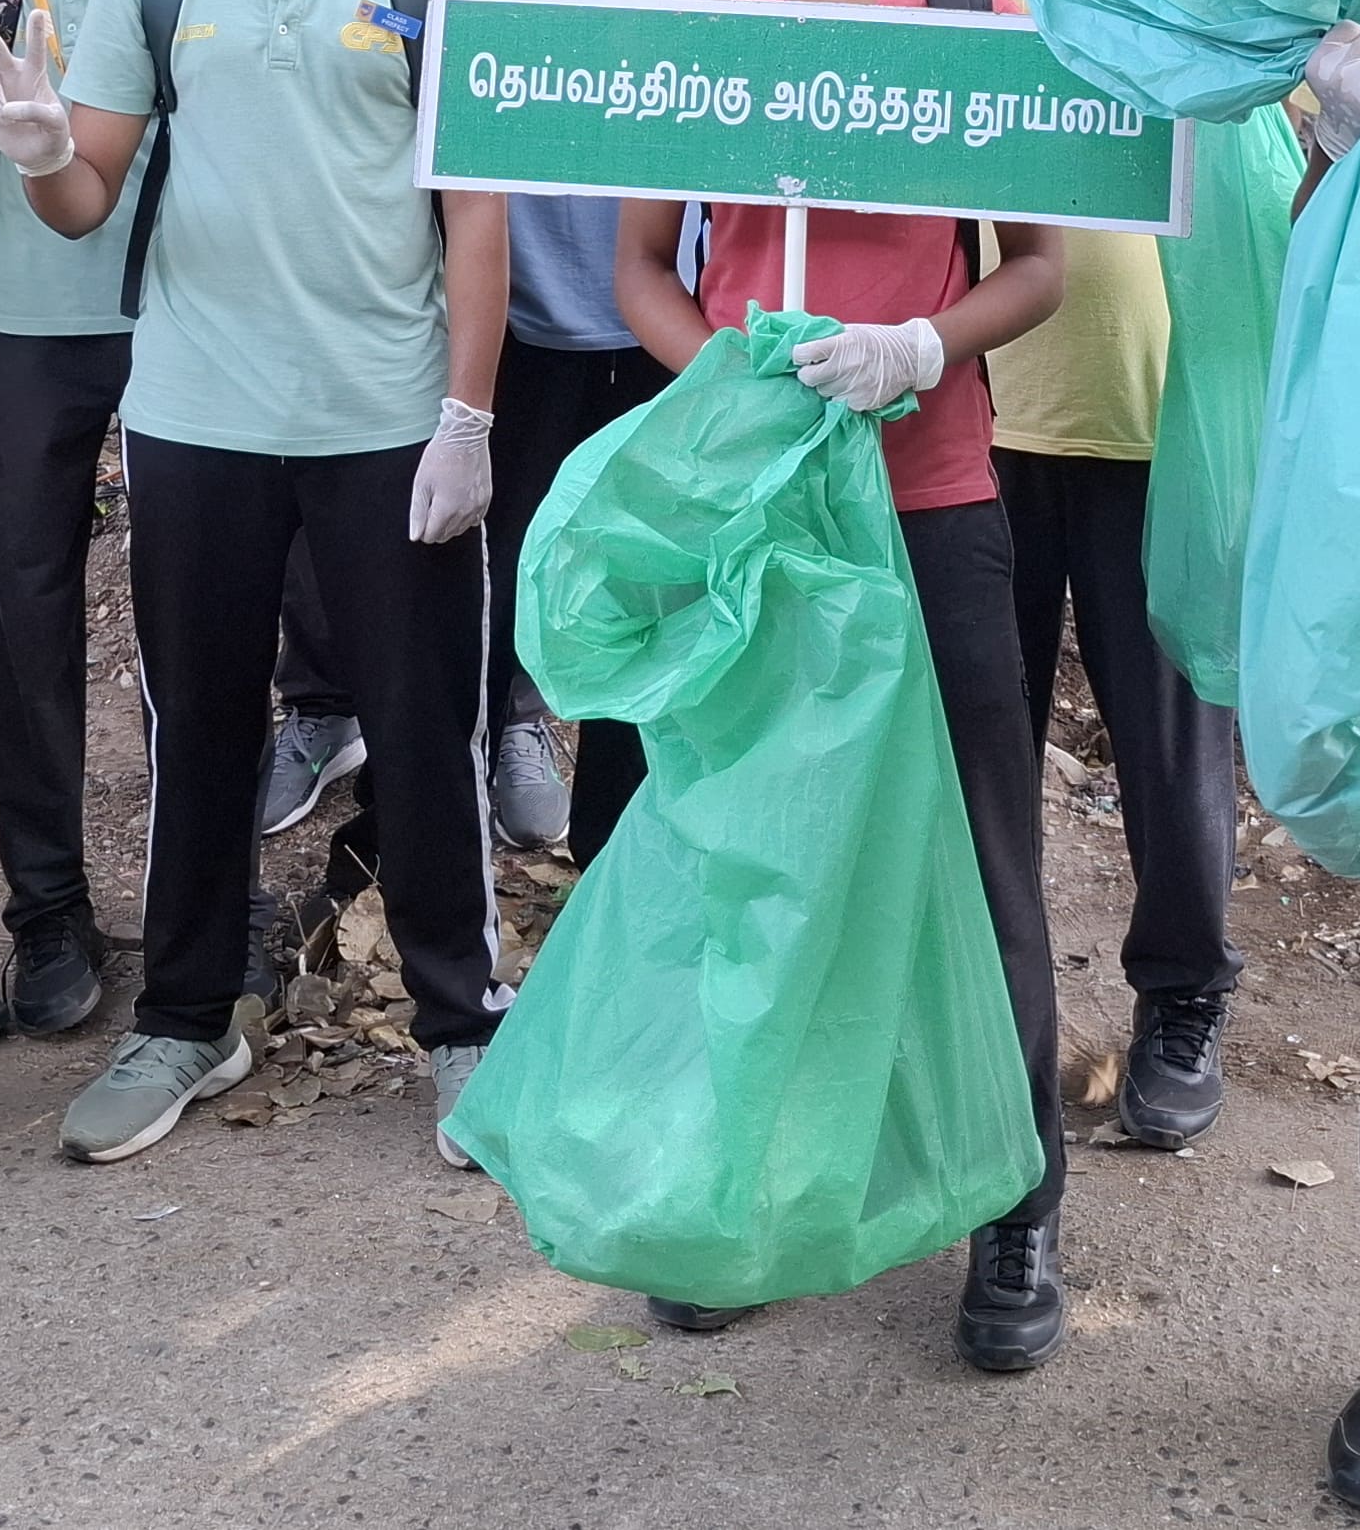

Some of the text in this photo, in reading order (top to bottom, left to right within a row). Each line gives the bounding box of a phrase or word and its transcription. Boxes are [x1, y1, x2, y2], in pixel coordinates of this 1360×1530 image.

[467, 50, 1146, 149] தெய்வத்திற்கு அடுத்தது தூய்மை
